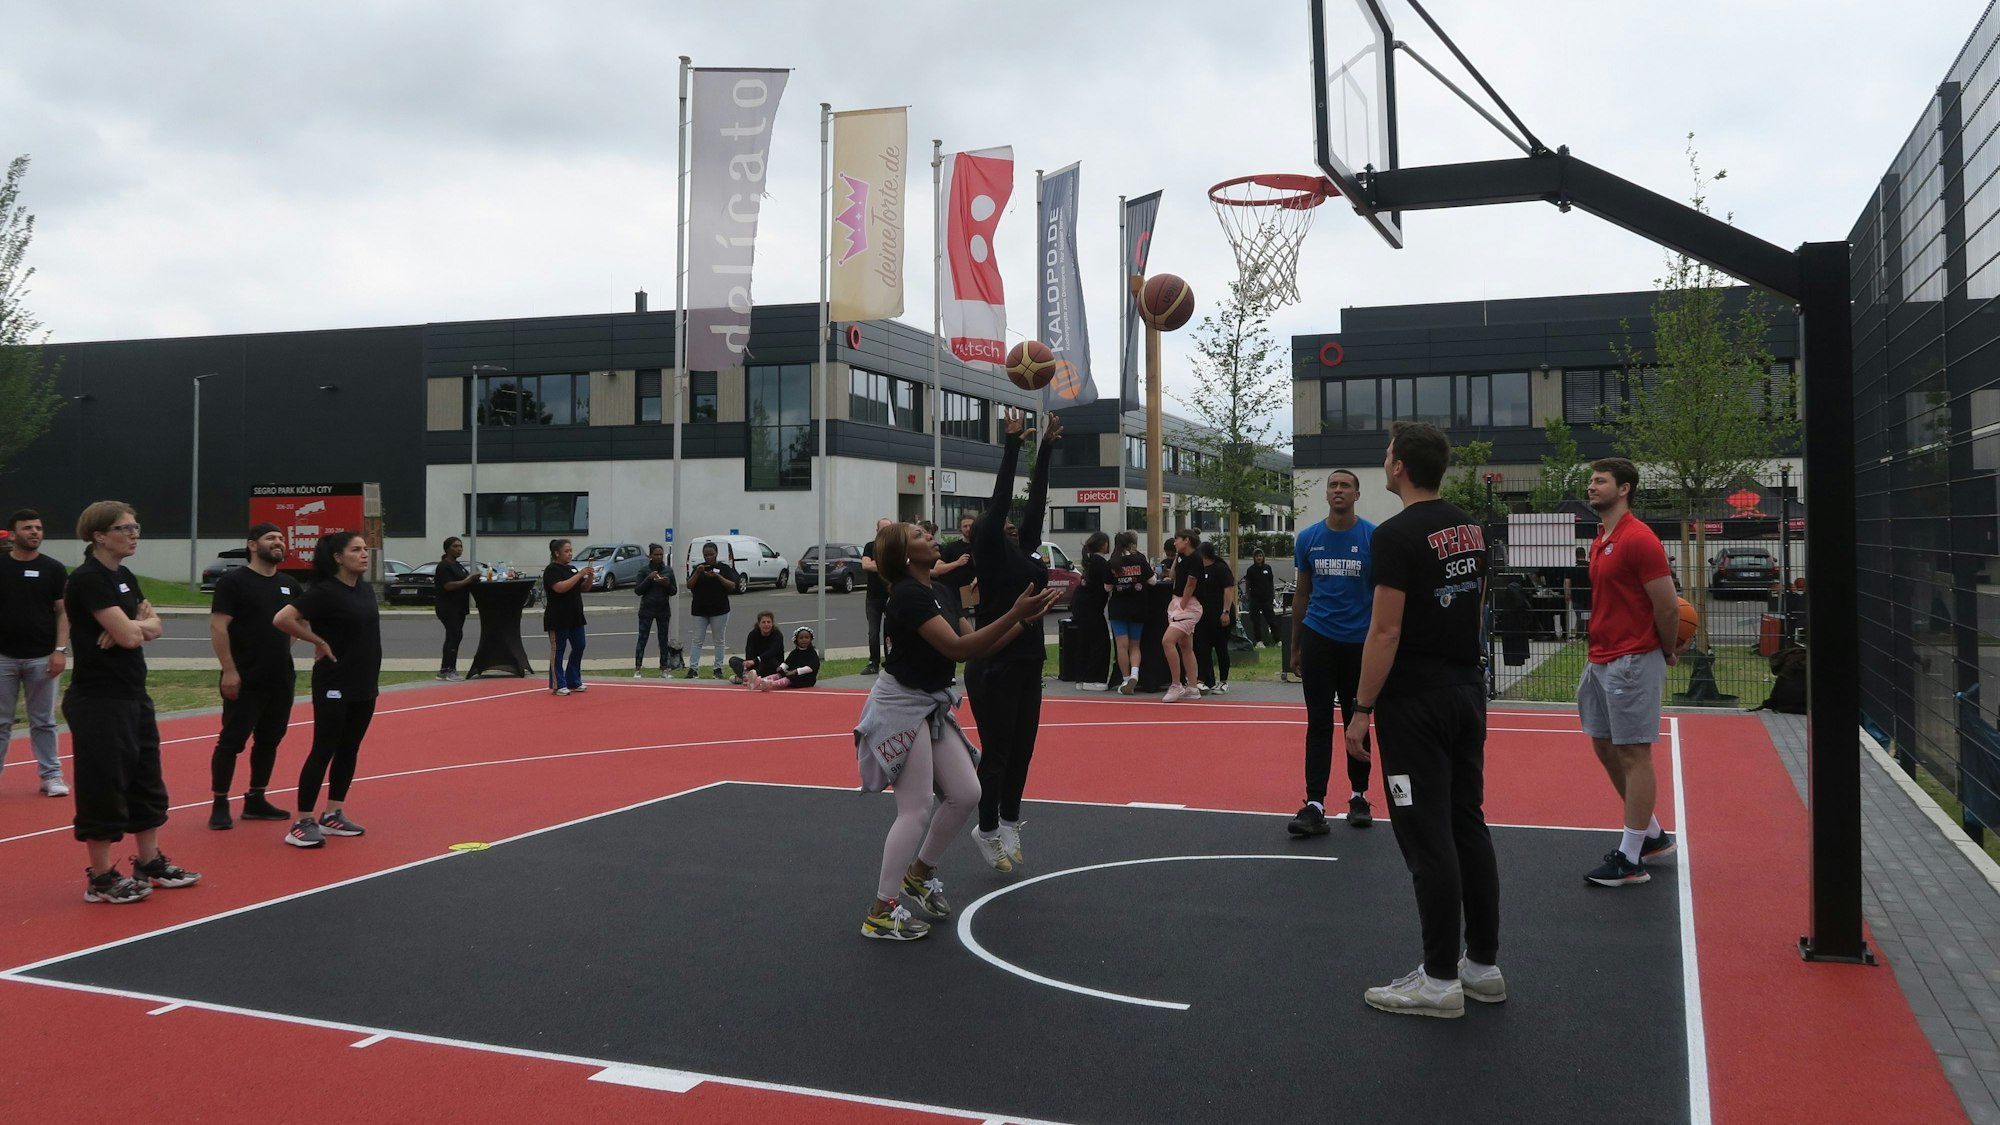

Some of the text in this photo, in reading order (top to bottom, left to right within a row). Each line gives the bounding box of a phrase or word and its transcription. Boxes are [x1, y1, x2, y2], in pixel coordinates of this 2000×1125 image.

[871, 145, 901, 288] deineTorte.de
[1047, 207, 1064, 353] KALOPO.DE
[254, 487, 276, 495] SEGRO
[277, 486, 294, 494] PARK
[296, 485, 315, 493] KÖLN
[1314, 559, 1361, 571] RHEINSTARS
[1329, 569, 1360, 577] BASKETBALL
